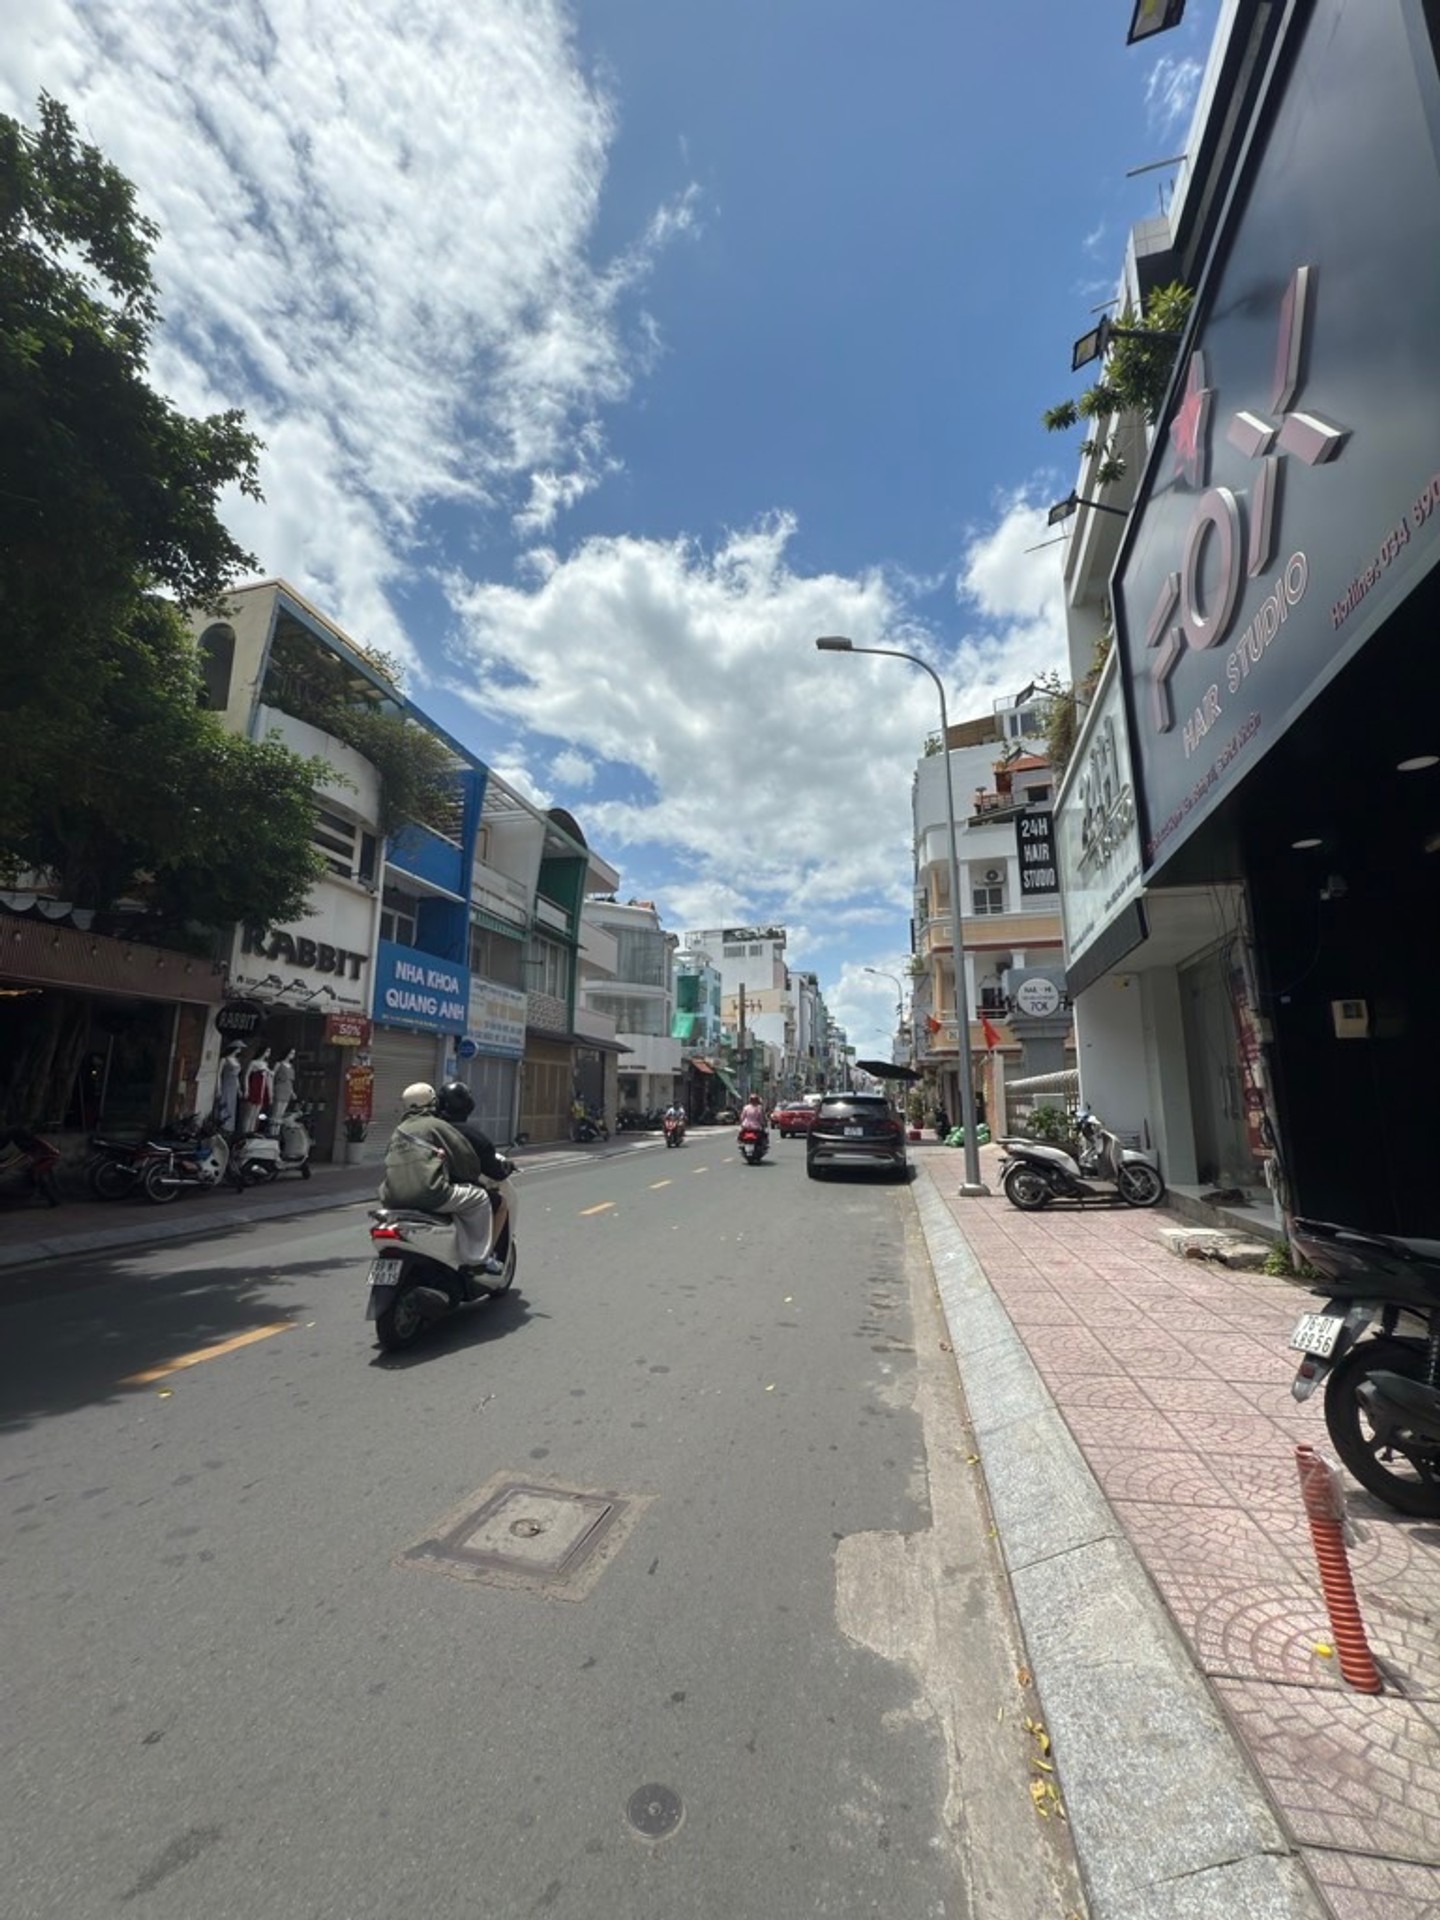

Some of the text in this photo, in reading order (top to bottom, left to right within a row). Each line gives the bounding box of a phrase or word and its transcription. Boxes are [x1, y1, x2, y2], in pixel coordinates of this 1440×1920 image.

[1182, 683, 1222, 760] HAIR
[1226, 551, 1308, 695] STUDIO
[1021, 817, 1048, 838] 24H
[1023, 843, 1049, 862] HAIR
[1023, 867, 1055, 888] STUDIO
[241, 920, 368, 981] RABBIT
[395, 960, 425, 986] NHA
[427, 969, 459, 994] KHOA
[385, 988, 437, 1016] QUANG
[439, 1002, 465, 1021] ANH
